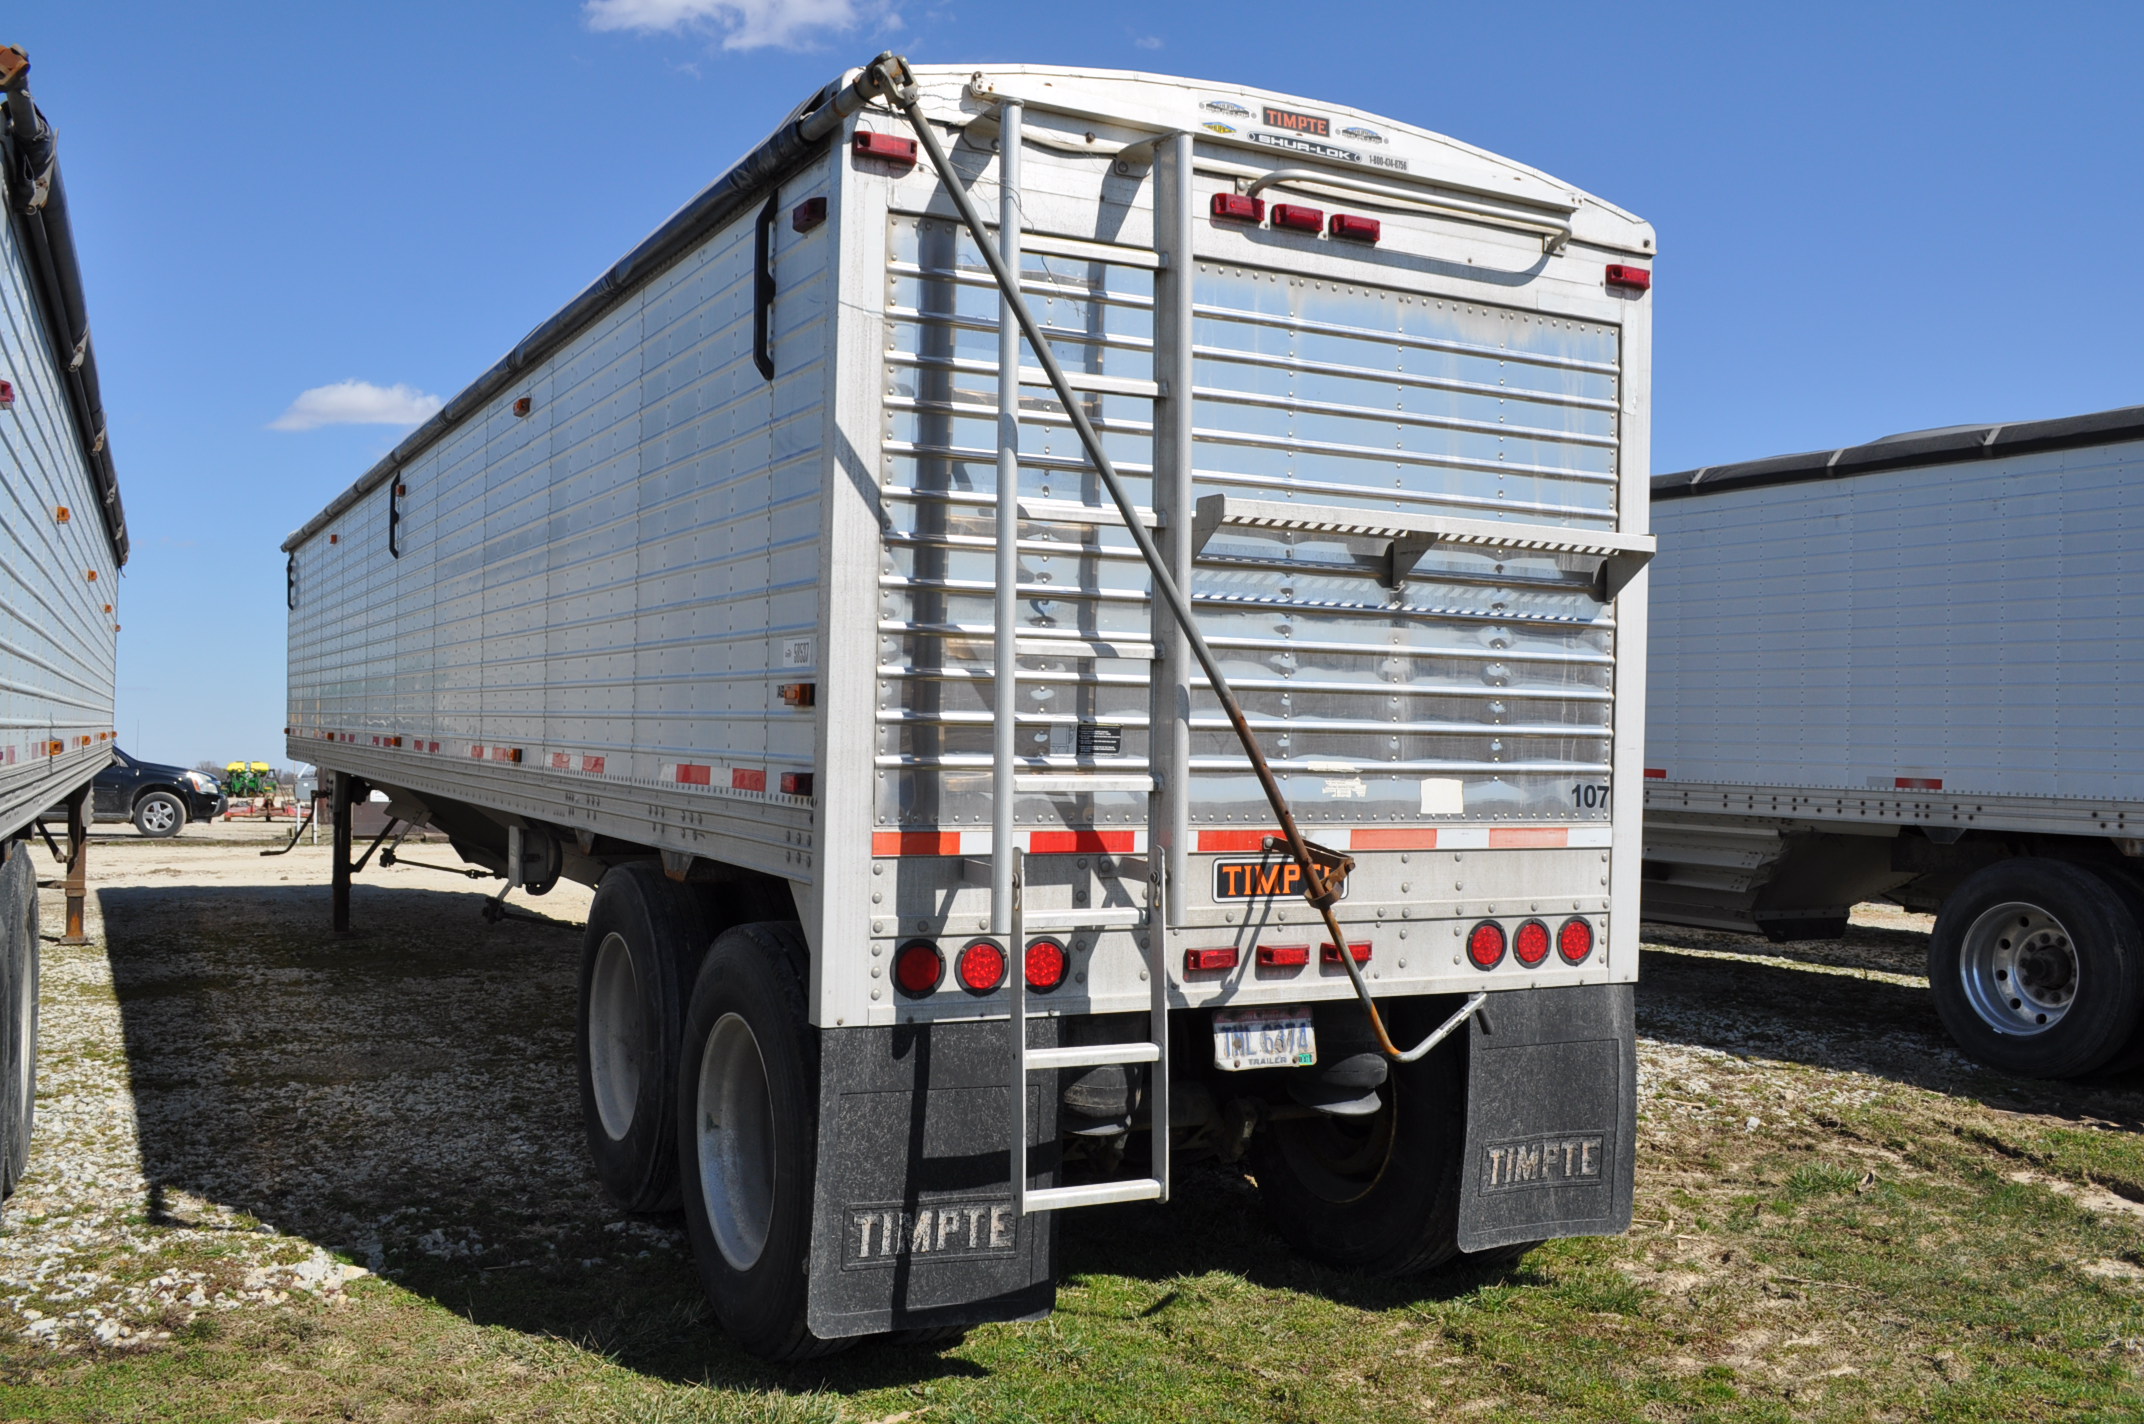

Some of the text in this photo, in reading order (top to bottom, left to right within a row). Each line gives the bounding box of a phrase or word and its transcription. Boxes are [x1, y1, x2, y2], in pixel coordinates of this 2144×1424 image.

[1266, 109, 1327, 135] TIMPTE
[1571, 784, 1610, 808] 107
[1222, 863, 1333, 896] TIMP
[1248, 1056, 1288, 1066] TRAILER
[1487, 1139, 1599, 1185] TIMPTE
[853, 1204, 1013, 1259] TIMPTE
